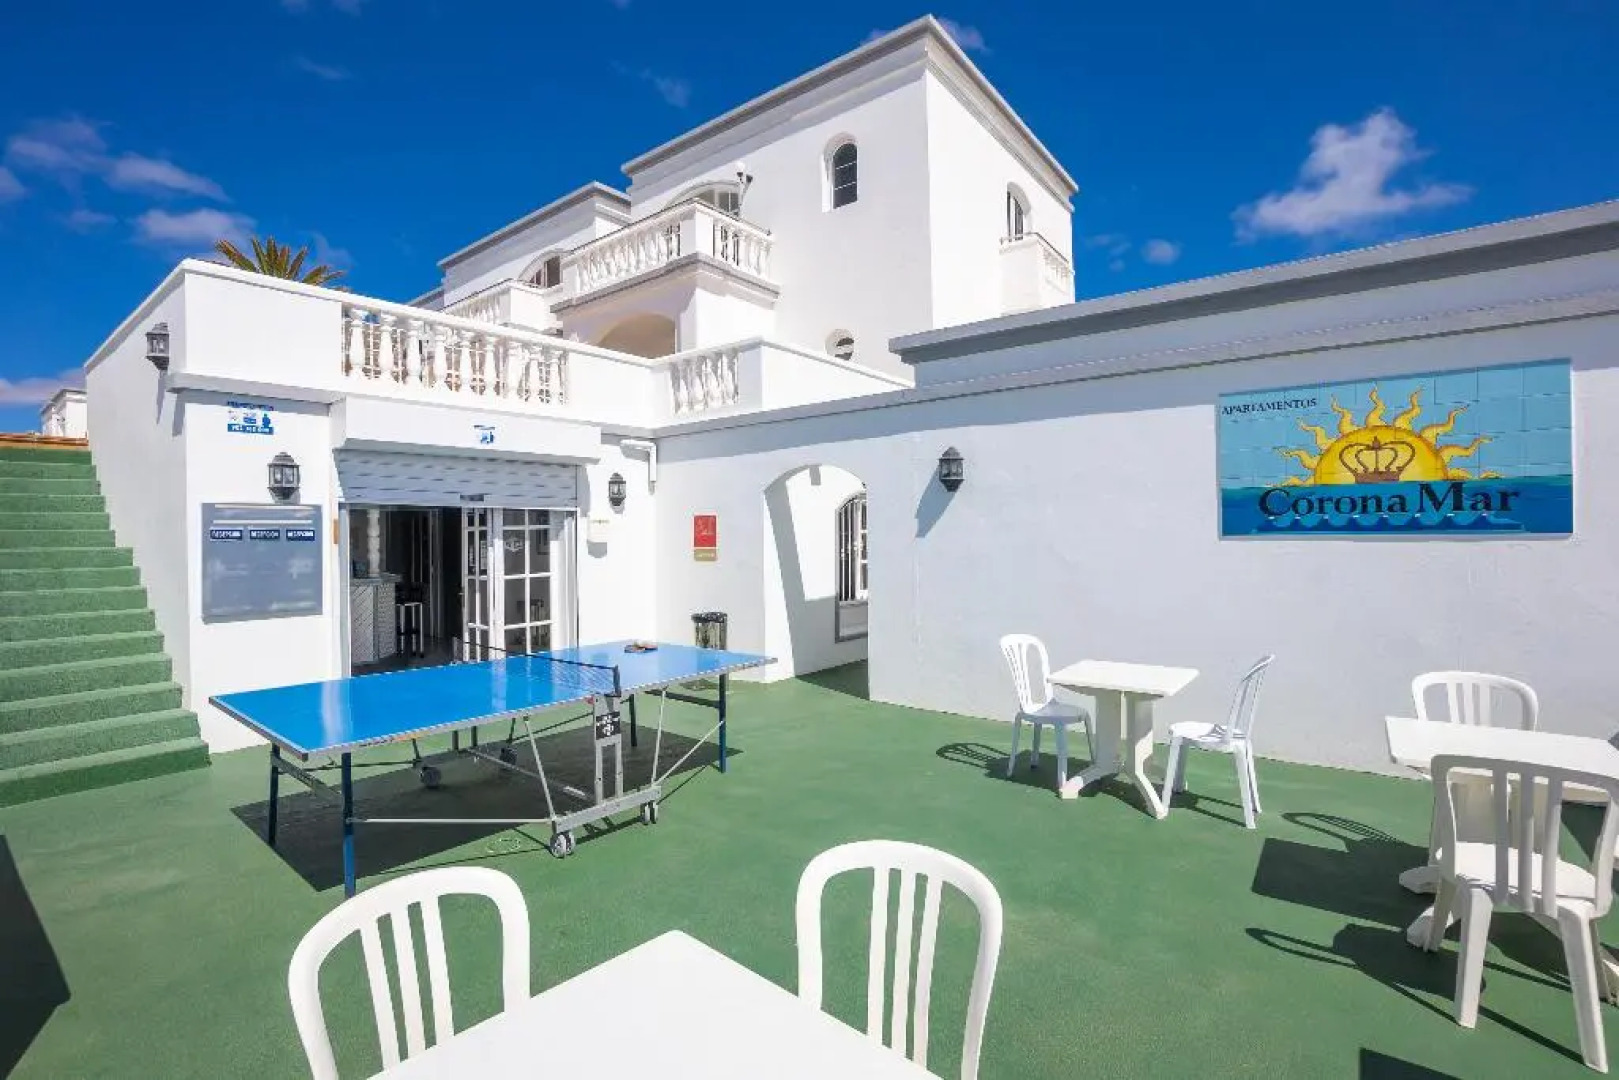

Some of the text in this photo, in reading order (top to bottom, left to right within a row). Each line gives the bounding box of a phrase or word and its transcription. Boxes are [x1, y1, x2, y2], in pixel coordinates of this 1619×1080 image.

[1221, 398, 1317, 415] APARTAMENTOS
[1259, 482, 1520, 517] Corona Mar
